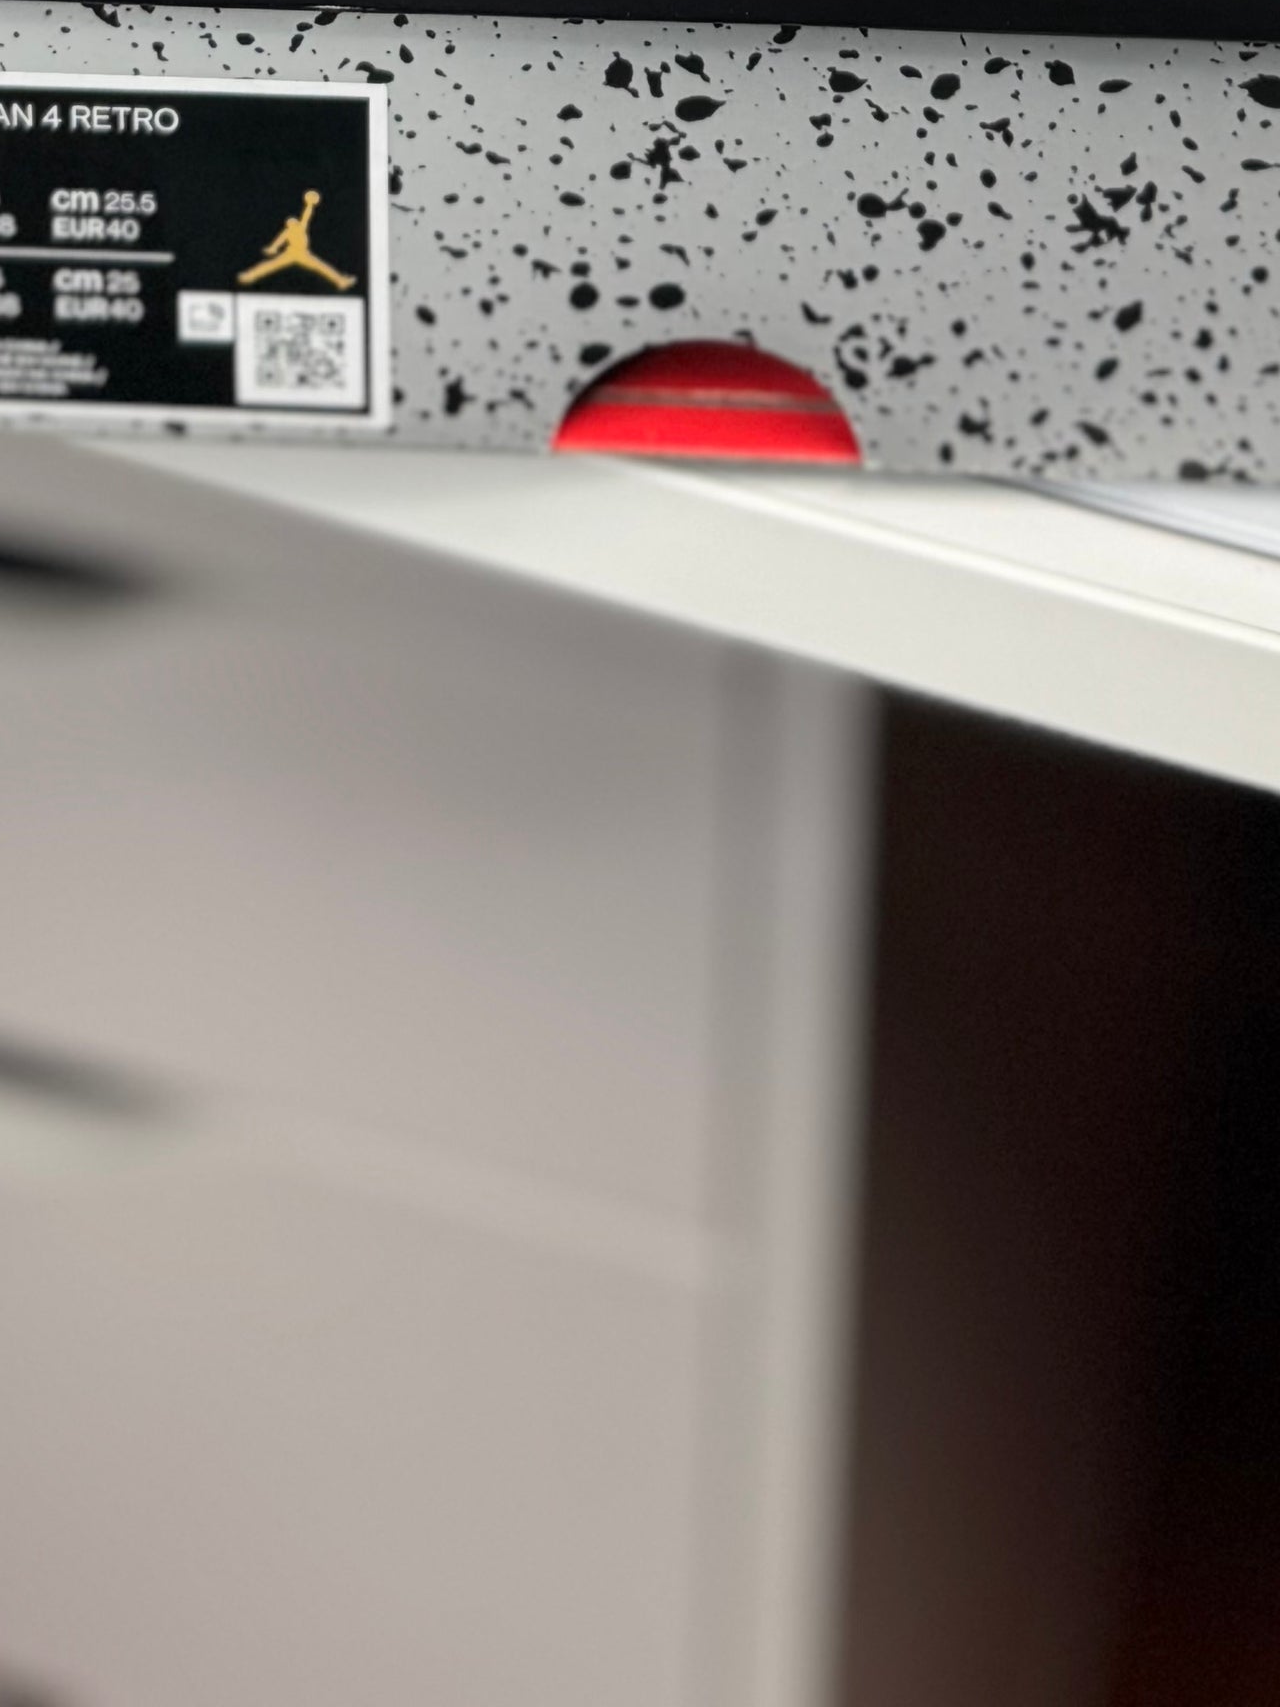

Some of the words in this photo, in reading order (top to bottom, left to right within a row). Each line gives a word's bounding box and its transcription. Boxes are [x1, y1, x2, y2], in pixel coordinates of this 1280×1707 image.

[41, 104, 63, 131] 4
[68, 105, 180, 135] RETRO
[49, 188, 100, 214] cm
[104, 190, 157, 215] 25.5
